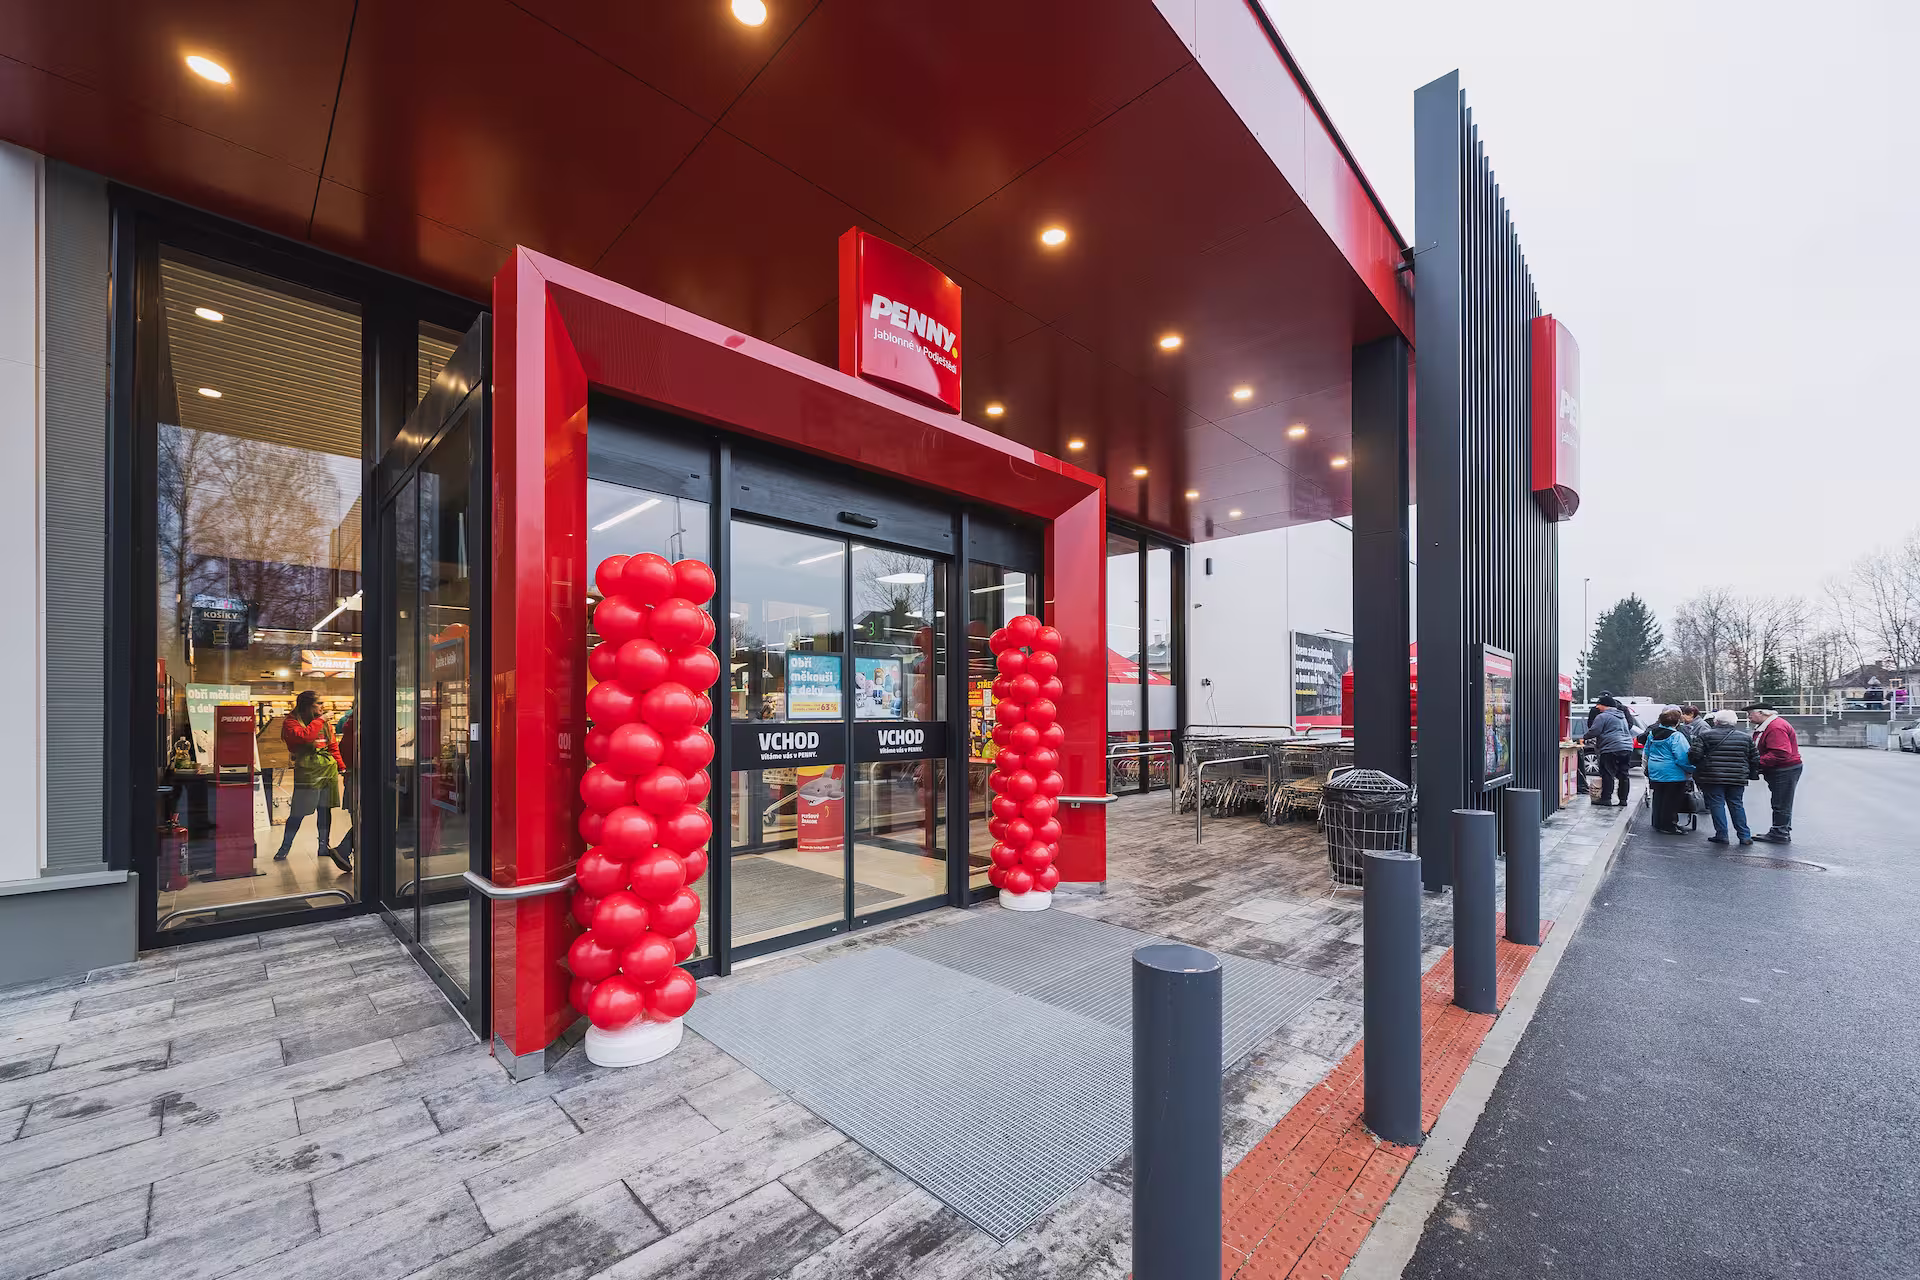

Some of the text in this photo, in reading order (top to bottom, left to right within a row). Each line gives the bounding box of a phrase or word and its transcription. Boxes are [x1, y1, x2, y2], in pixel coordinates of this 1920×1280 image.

[873, 327, 957, 375] Jablonné v Podještědí
[203, 610, 238, 619] KOŠÍKY
[869, 621, 875, 636] 3
[791, 656, 812, 668] Obří
[791, 670, 833, 682] měkouši
[188, 688, 208, 699] Obří
[800, 684, 824, 697] deky
[189, 705, 196, 713] a
[758, 731, 820, 751] VCHOD
[877, 729, 925, 746] VCHOD
[761, 752, 782, 760] Vítáme
